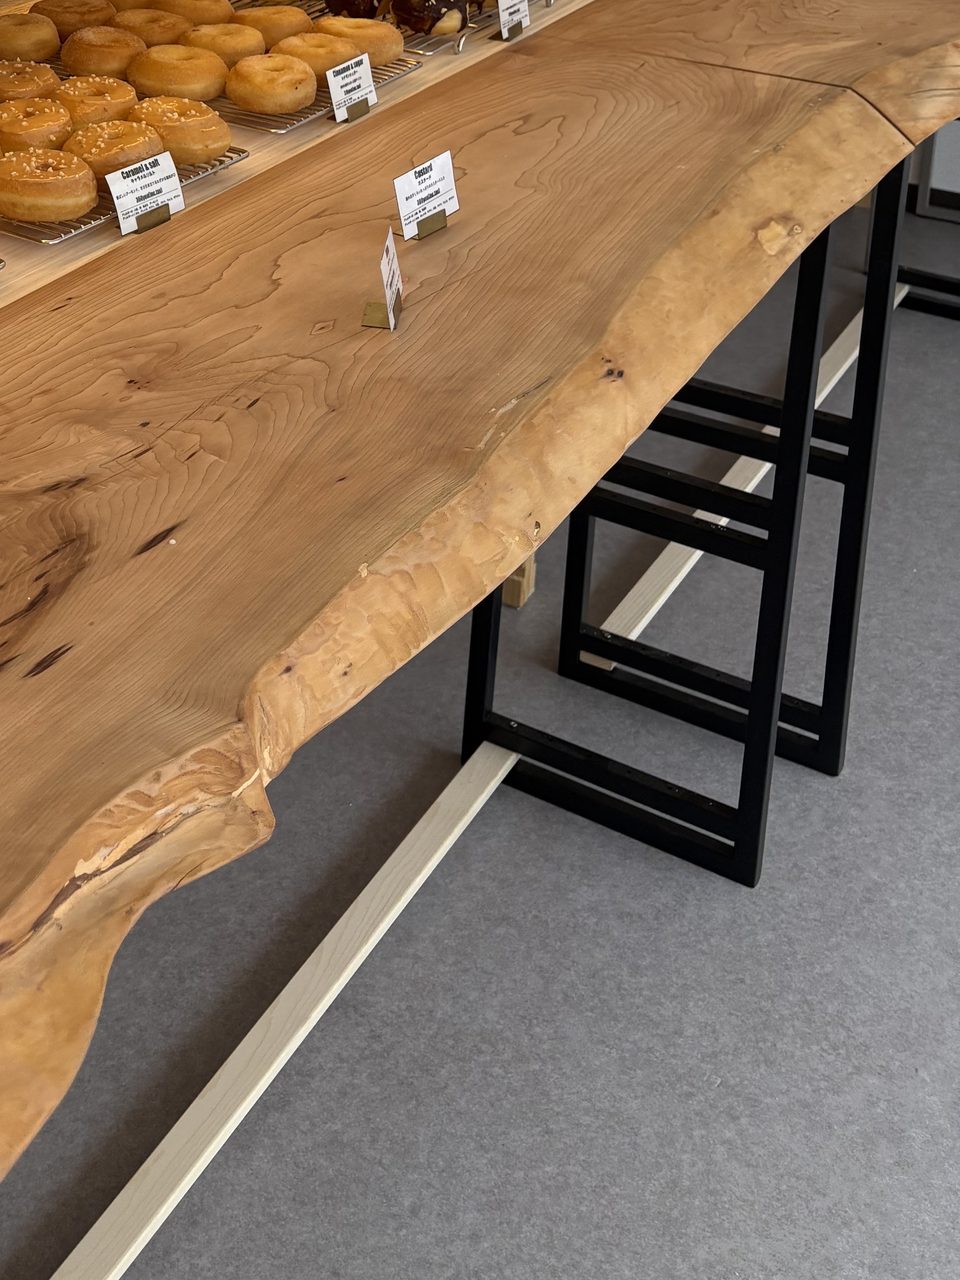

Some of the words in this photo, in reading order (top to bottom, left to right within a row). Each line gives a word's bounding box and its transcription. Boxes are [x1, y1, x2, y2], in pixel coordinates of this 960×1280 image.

[121, 163, 145, 180] Caramel
[148, 158, 161, 169] salt
[413, 162, 434, 180] Custard
